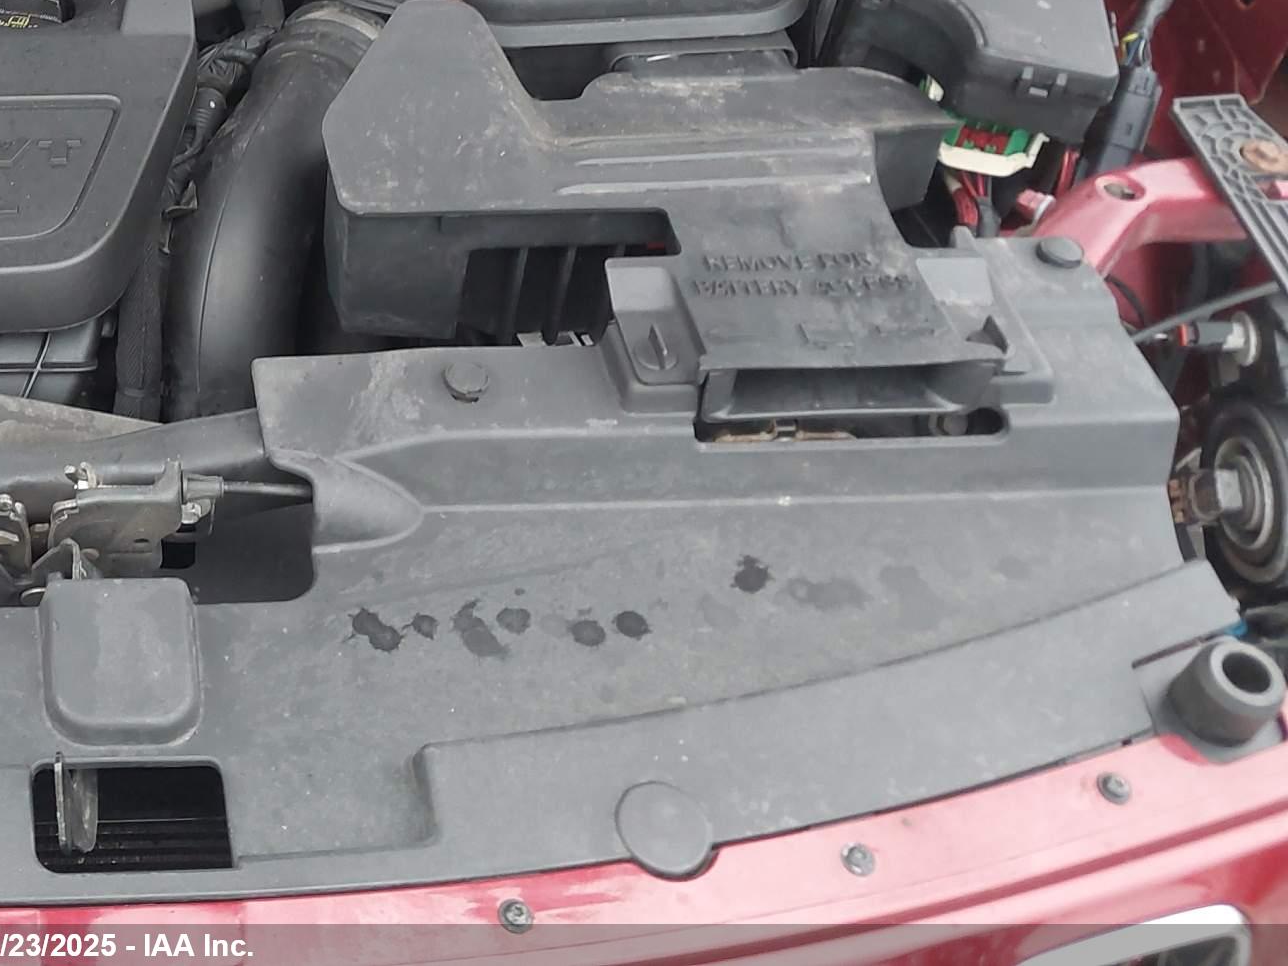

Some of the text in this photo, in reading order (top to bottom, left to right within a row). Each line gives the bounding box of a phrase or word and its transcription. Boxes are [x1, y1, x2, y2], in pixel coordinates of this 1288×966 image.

[702, 251, 872, 272] REMOVE FOR
[692, 278, 801, 297] BATTERY
